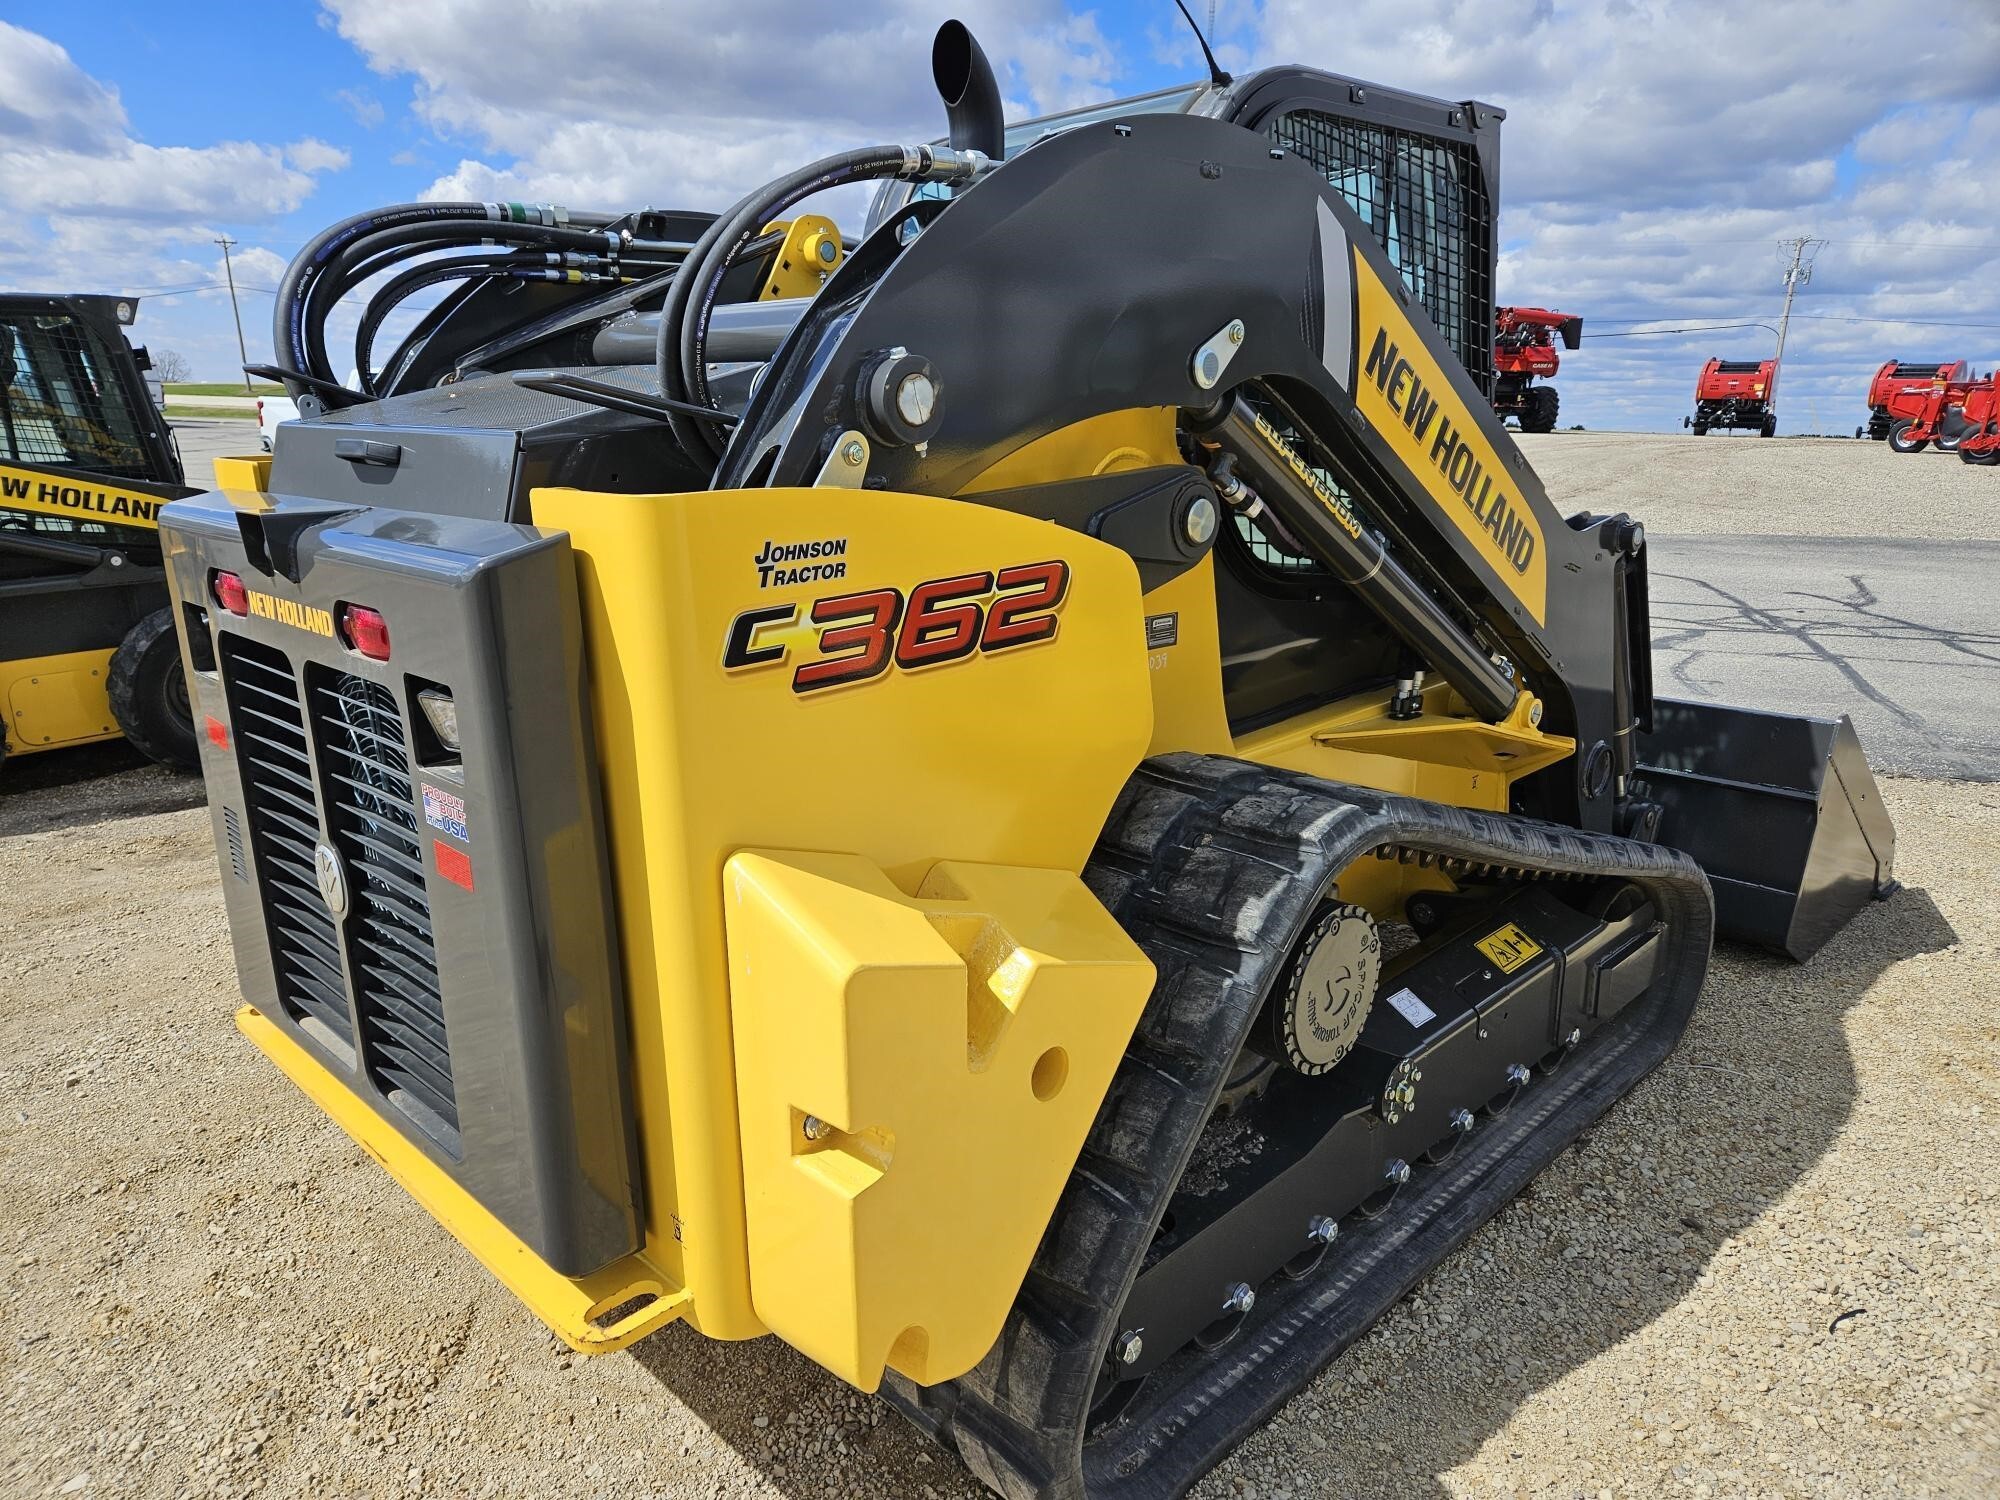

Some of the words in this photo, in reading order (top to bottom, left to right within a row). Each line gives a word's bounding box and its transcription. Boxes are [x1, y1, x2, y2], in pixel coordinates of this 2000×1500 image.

[1364, 326, 1439, 446] NEW
[1429, 415, 1535, 576] HOLLAND
[1255, 412, 1316, 488] SUPER
[1313, 478, 1363, 540] BOOM
[755, 539, 847, 565] JOHNSON
[757, 562, 847, 588] TRACTOR
[247, 589, 276, 620] NEW
[275, 597, 334, 638] HOLLAND
[723, 559, 1070, 695] C362
[421, 783, 464, 811] PROUDLY
[440, 804, 467, 824] BUILT
[442, 815, 469, 843] USA
[1343, 958, 1367, 1032] SPICER
